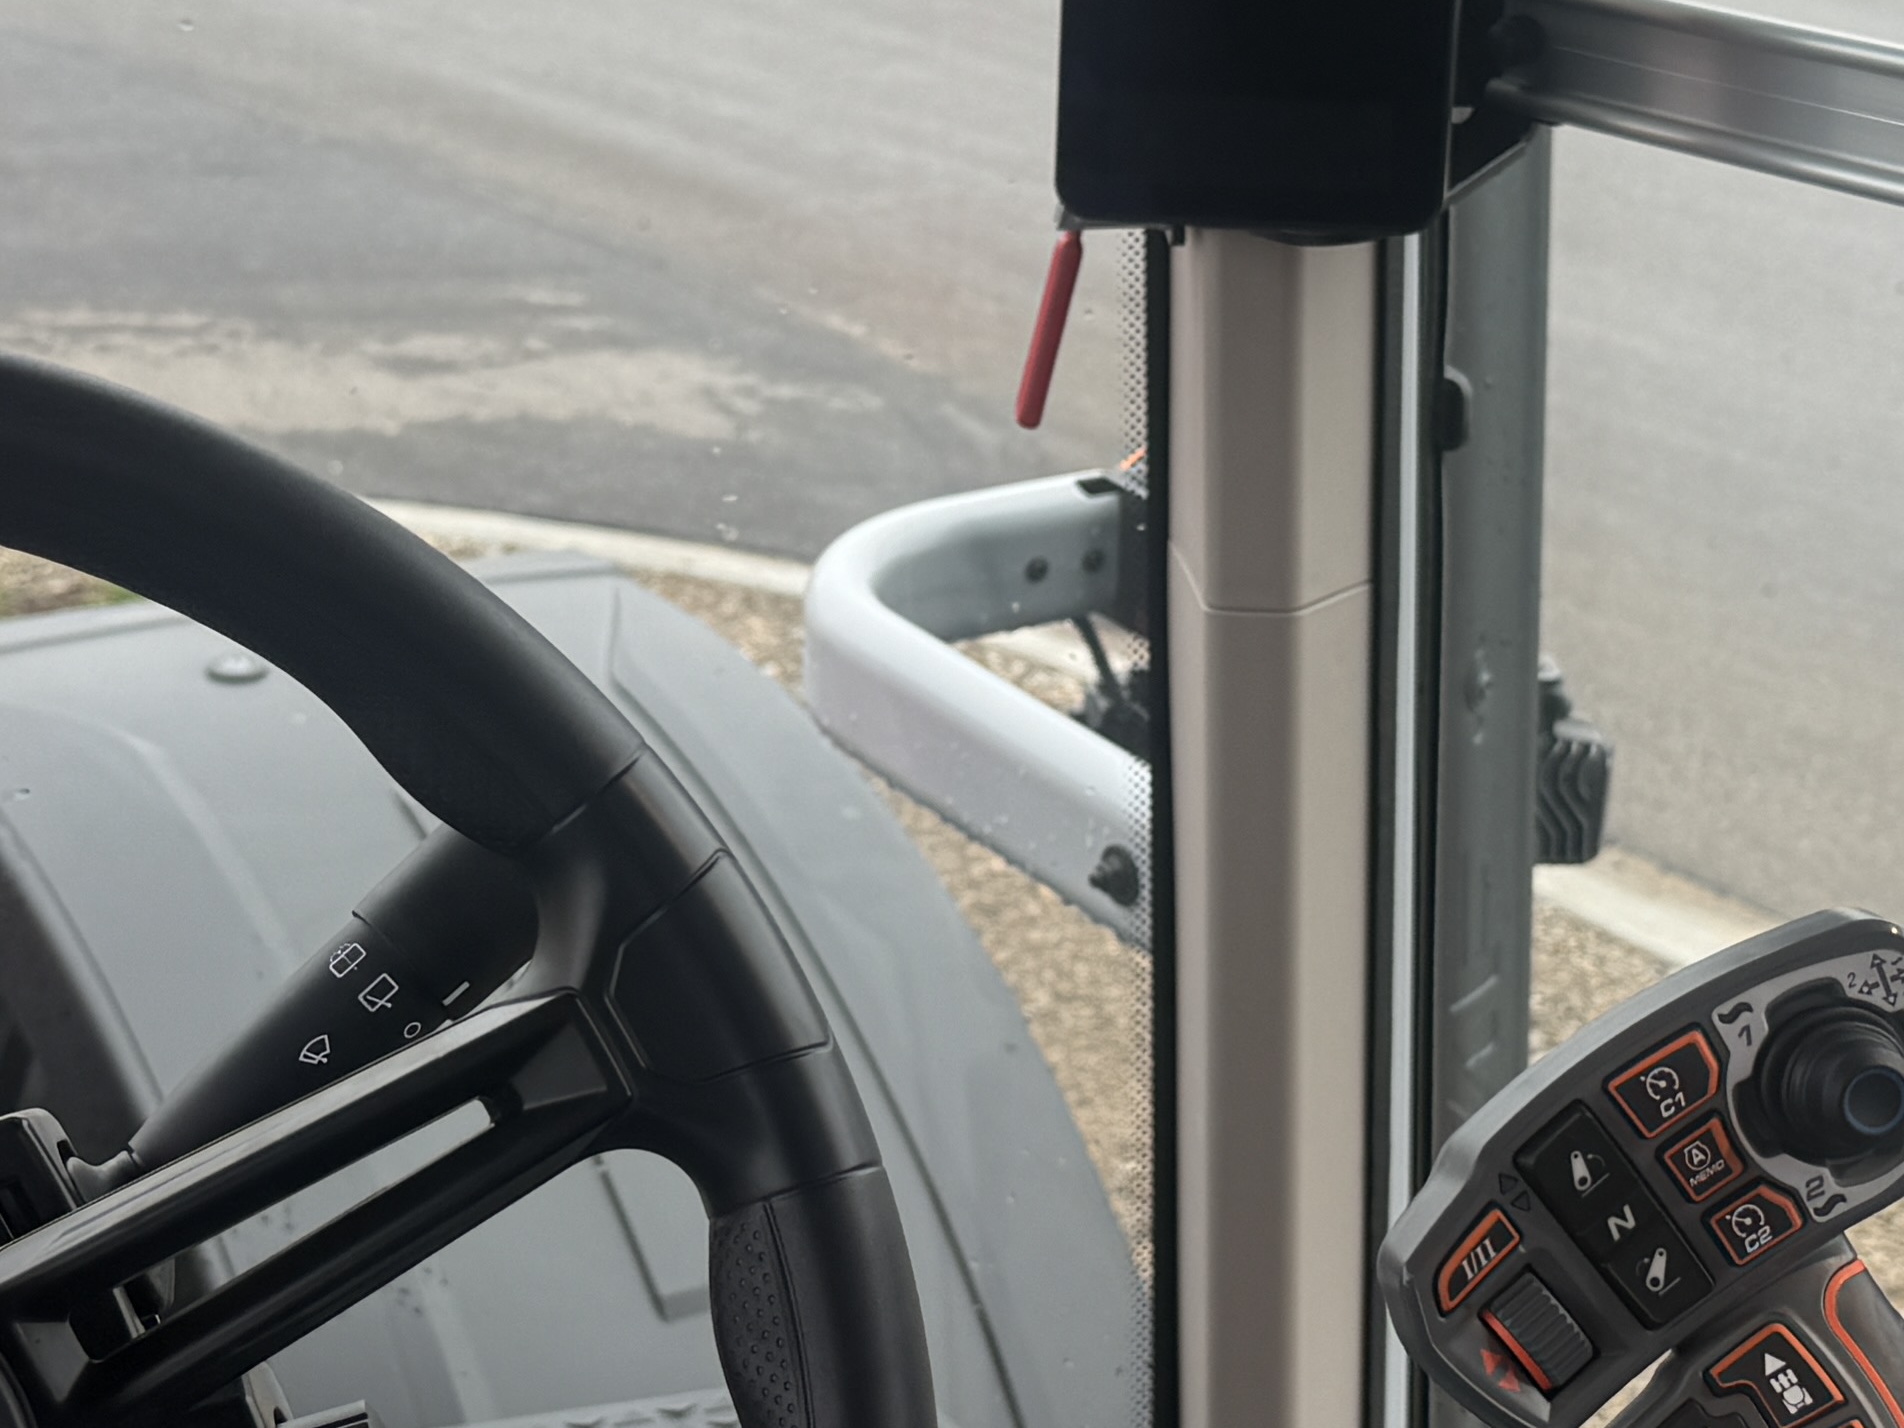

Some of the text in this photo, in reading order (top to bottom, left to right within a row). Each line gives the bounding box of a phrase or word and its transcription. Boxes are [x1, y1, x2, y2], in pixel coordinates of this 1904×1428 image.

[1659, 1090, 1687, 1119] C1
[1688, 1158, 1726, 1188] MEMO
[1607, 1203, 1637, 1242] N
[1744, 1224, 1774, 1254] C2
